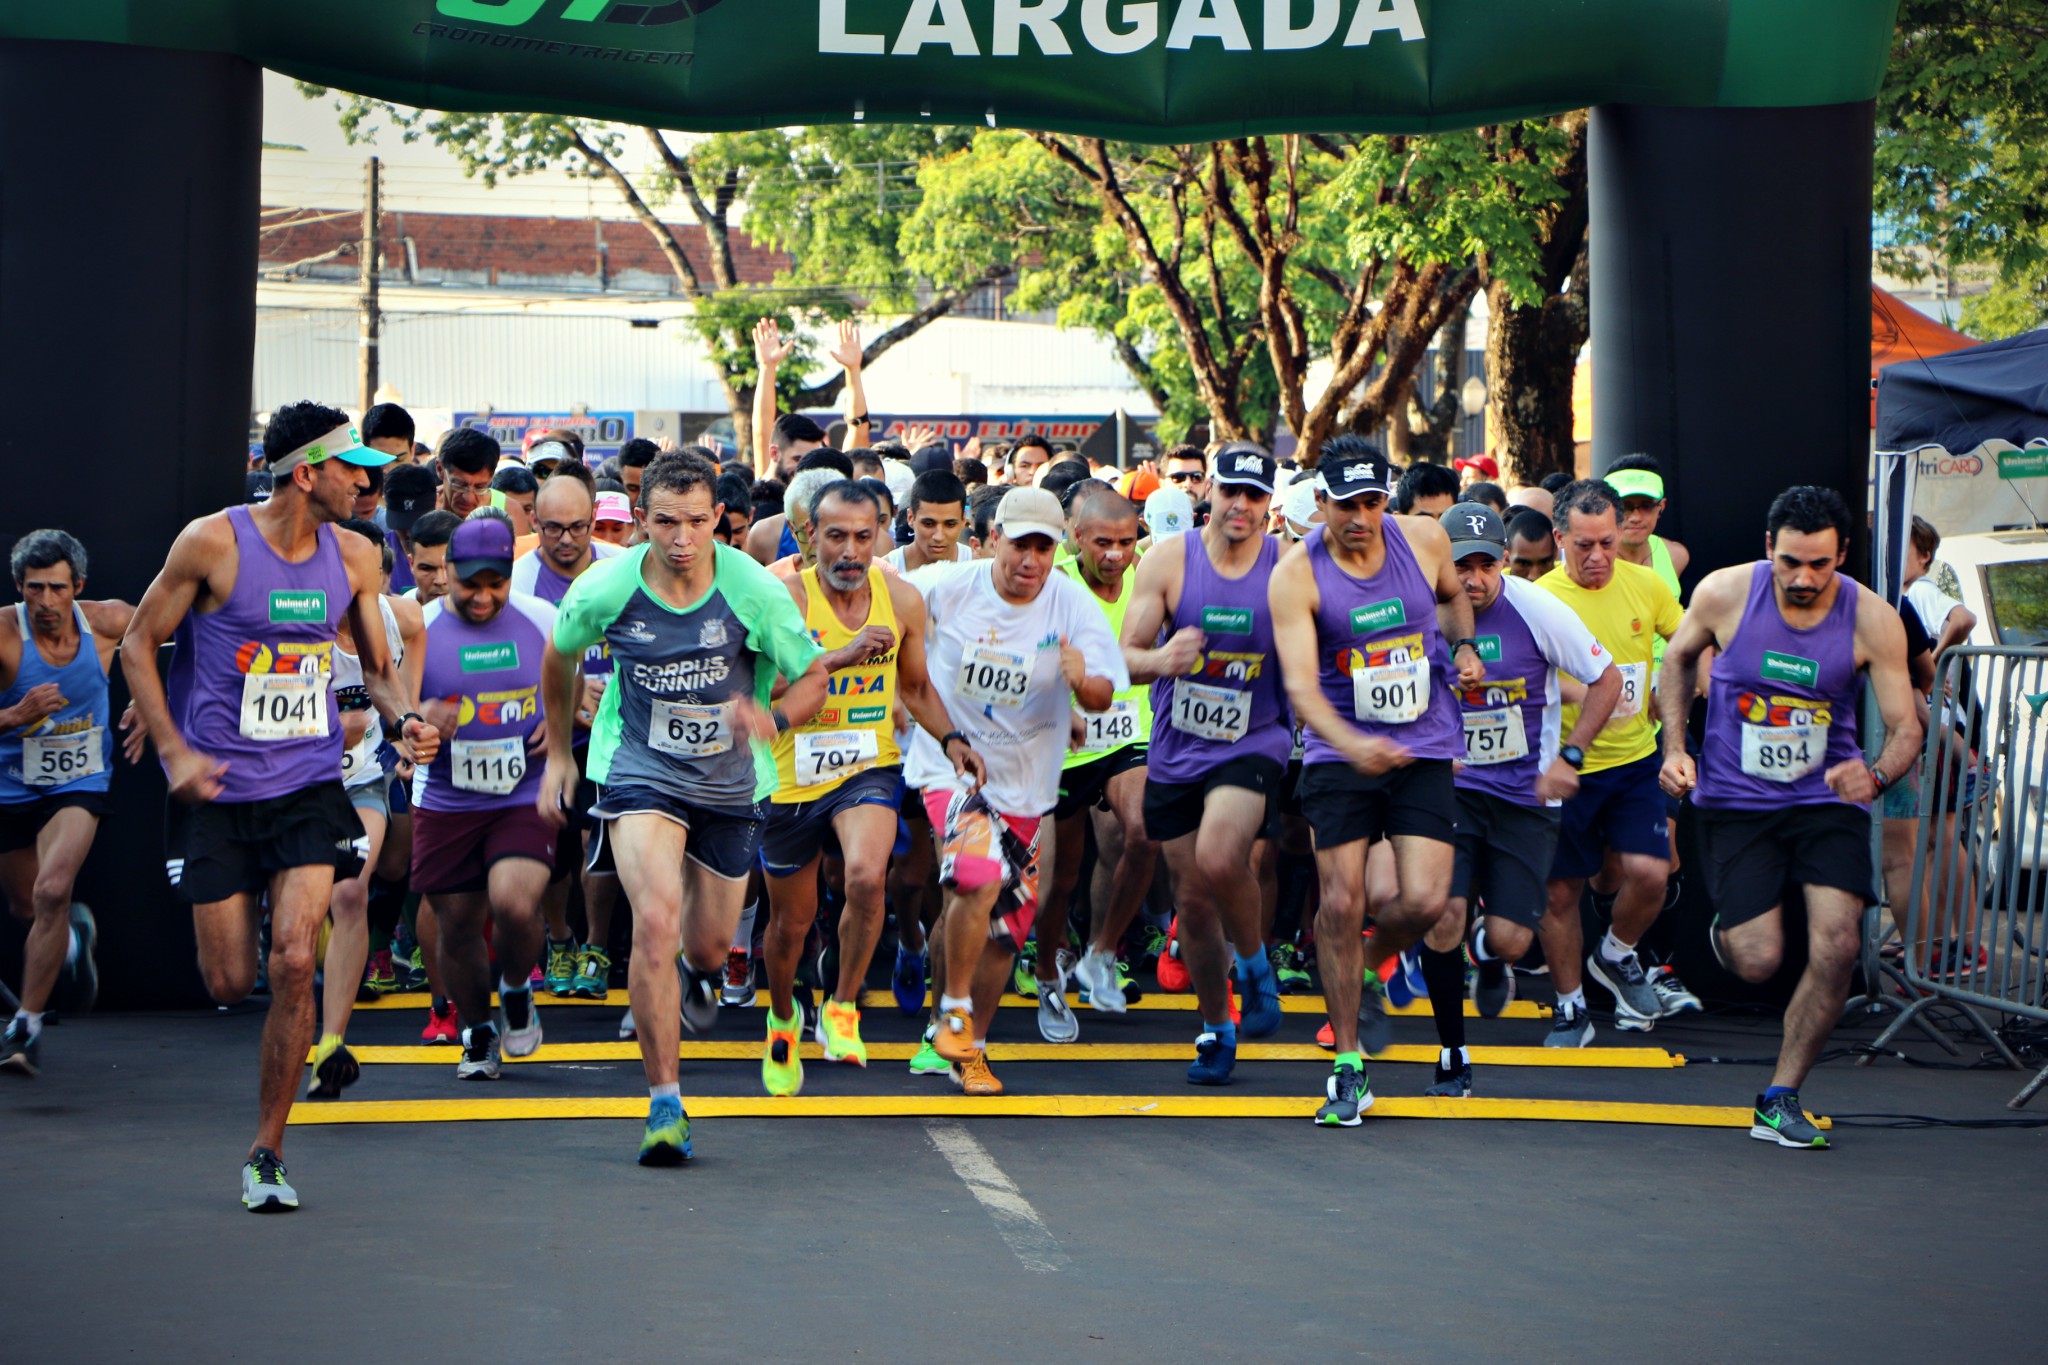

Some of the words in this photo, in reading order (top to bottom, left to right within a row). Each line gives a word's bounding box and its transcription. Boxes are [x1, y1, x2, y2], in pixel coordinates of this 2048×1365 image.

[818, 0, 1426, 55] LARGADA
[411, 20, 696, 66] CRONOMETRAGEM
[2003, 456, 2043, 466] Unimed
[275, 598, 309, 609] Unimed
[1355, 608, 1388, 624] Unimed
[464, 650, 499, 661] Unimed
[633, 655, 725, 678] CORPUS
[827, 674, 884, 696] AIXA
[964, 662, 1028, 696] 1083
[252, 691, 317, 722] 1041
[1371, 680, 1418, 709] 901
[851, 710, 877, 719] Unimed
[1180, 697, 1241, 731] 1042
[668, 717, 719, 745] 632
[1464, 726, 1508, 752] 757
[41, 744, 88, 773] 565
[462, 755, 523, 780] 1116
[810, 748, 861, 775] 797
[1759, 740, 1811, 769] 894
